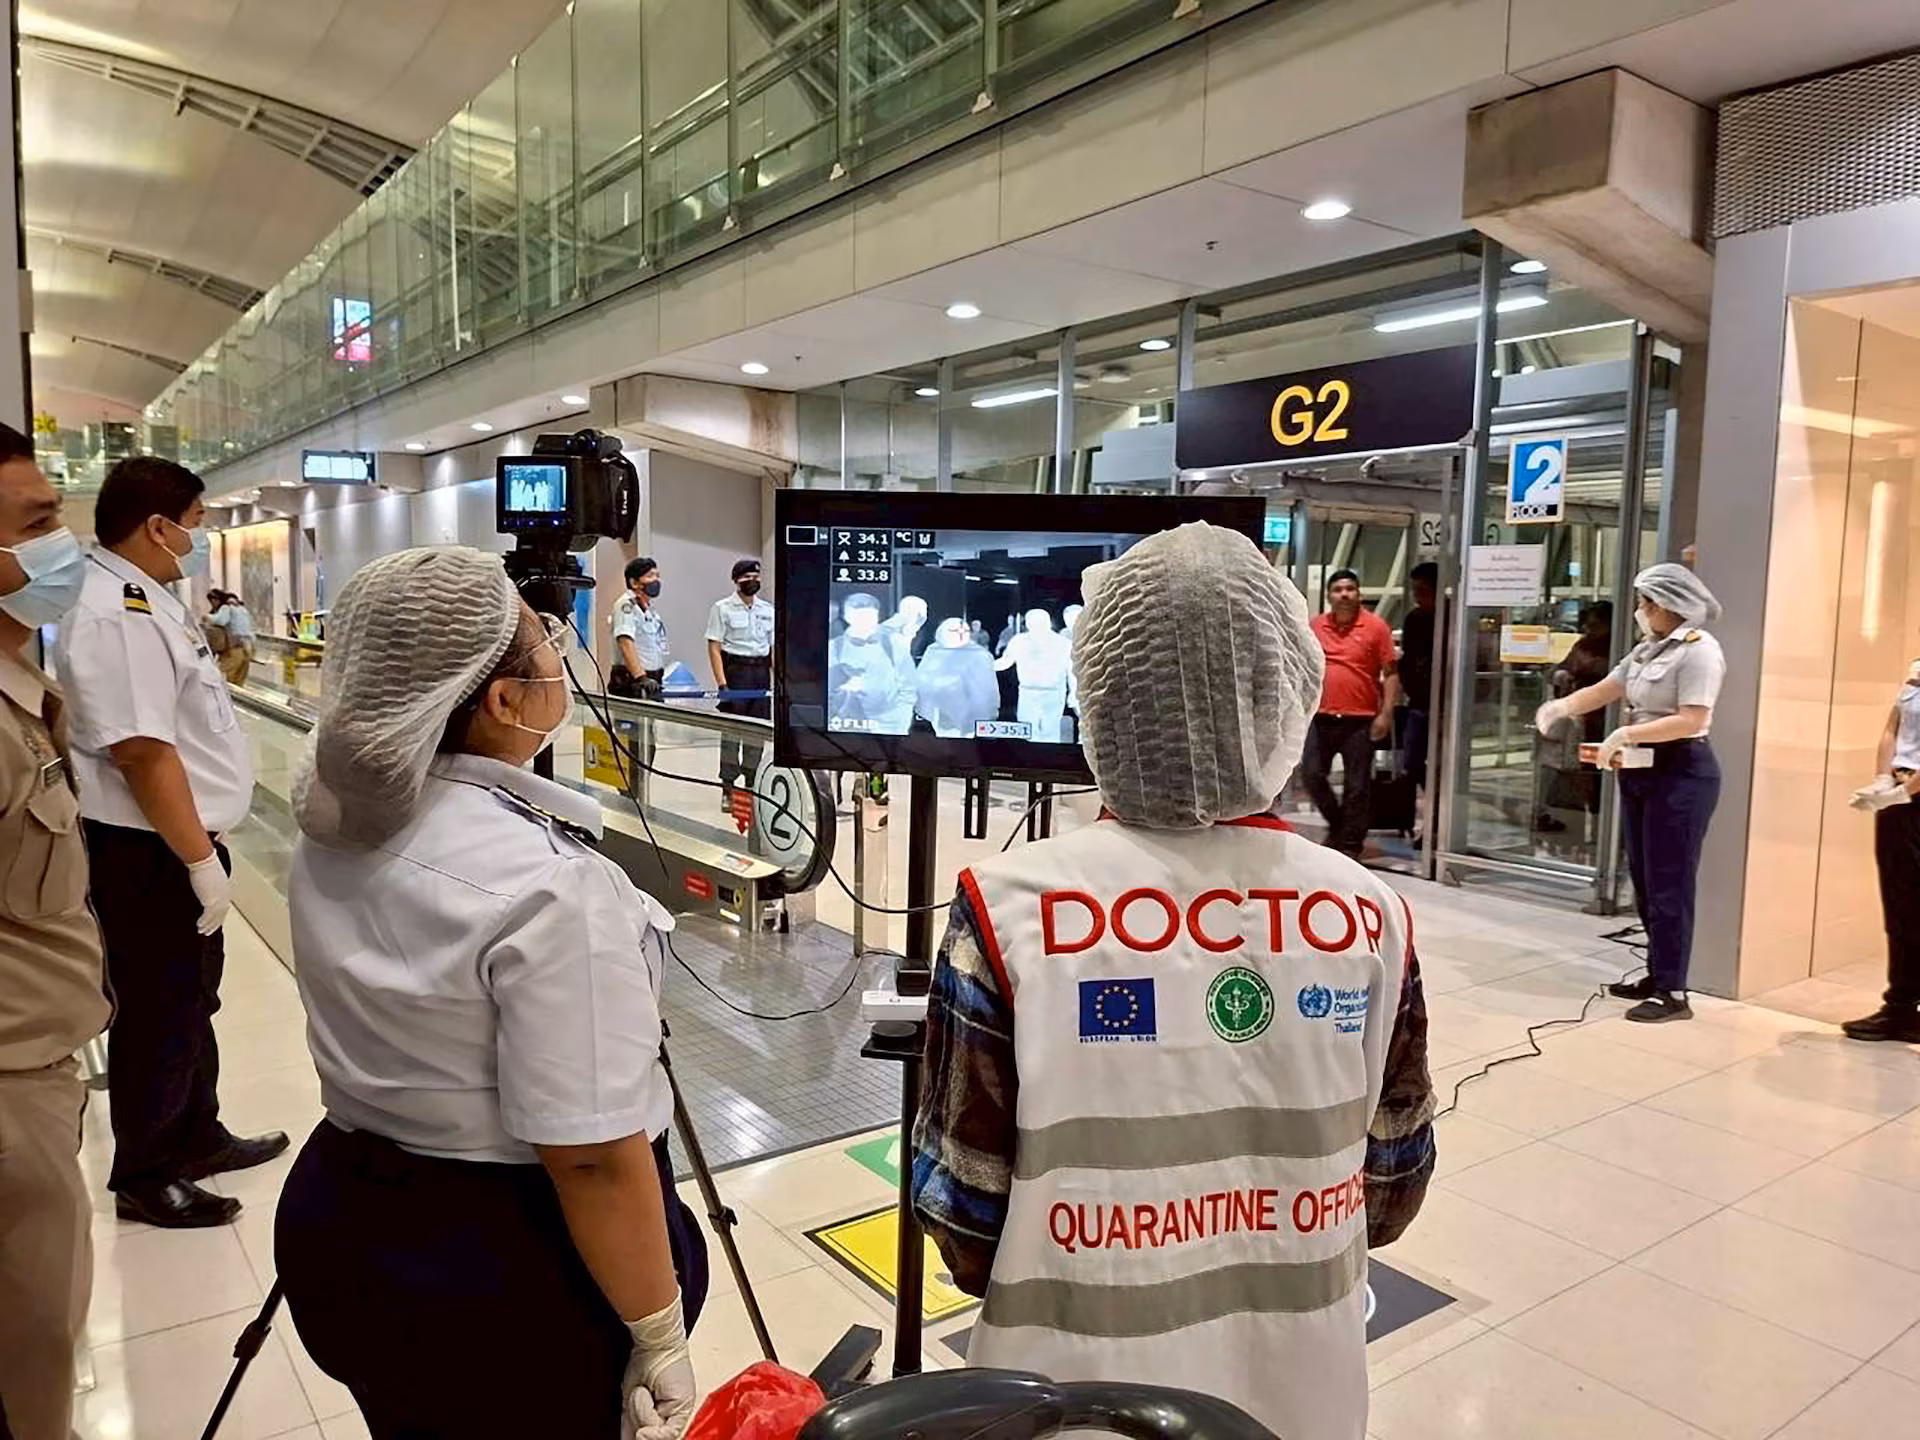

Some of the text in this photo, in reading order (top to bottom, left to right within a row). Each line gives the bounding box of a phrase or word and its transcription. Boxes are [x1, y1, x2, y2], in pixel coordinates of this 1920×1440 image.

[1271, 380, 1349, 446] G2
[1526, 445, 1561, 502] 2
[857, 532, 888, 545] 34.1
[857, 550, 888, 563] 35.1
[856, 569, 889, 582] 33.8
[1001, 726, 1029, 737] 35.1
[771, 774, 791, 840] 2
[1041, 888, 1382, 957] DOCTOR
[1049, 1188, 1279, 1254] QUARANTINE
